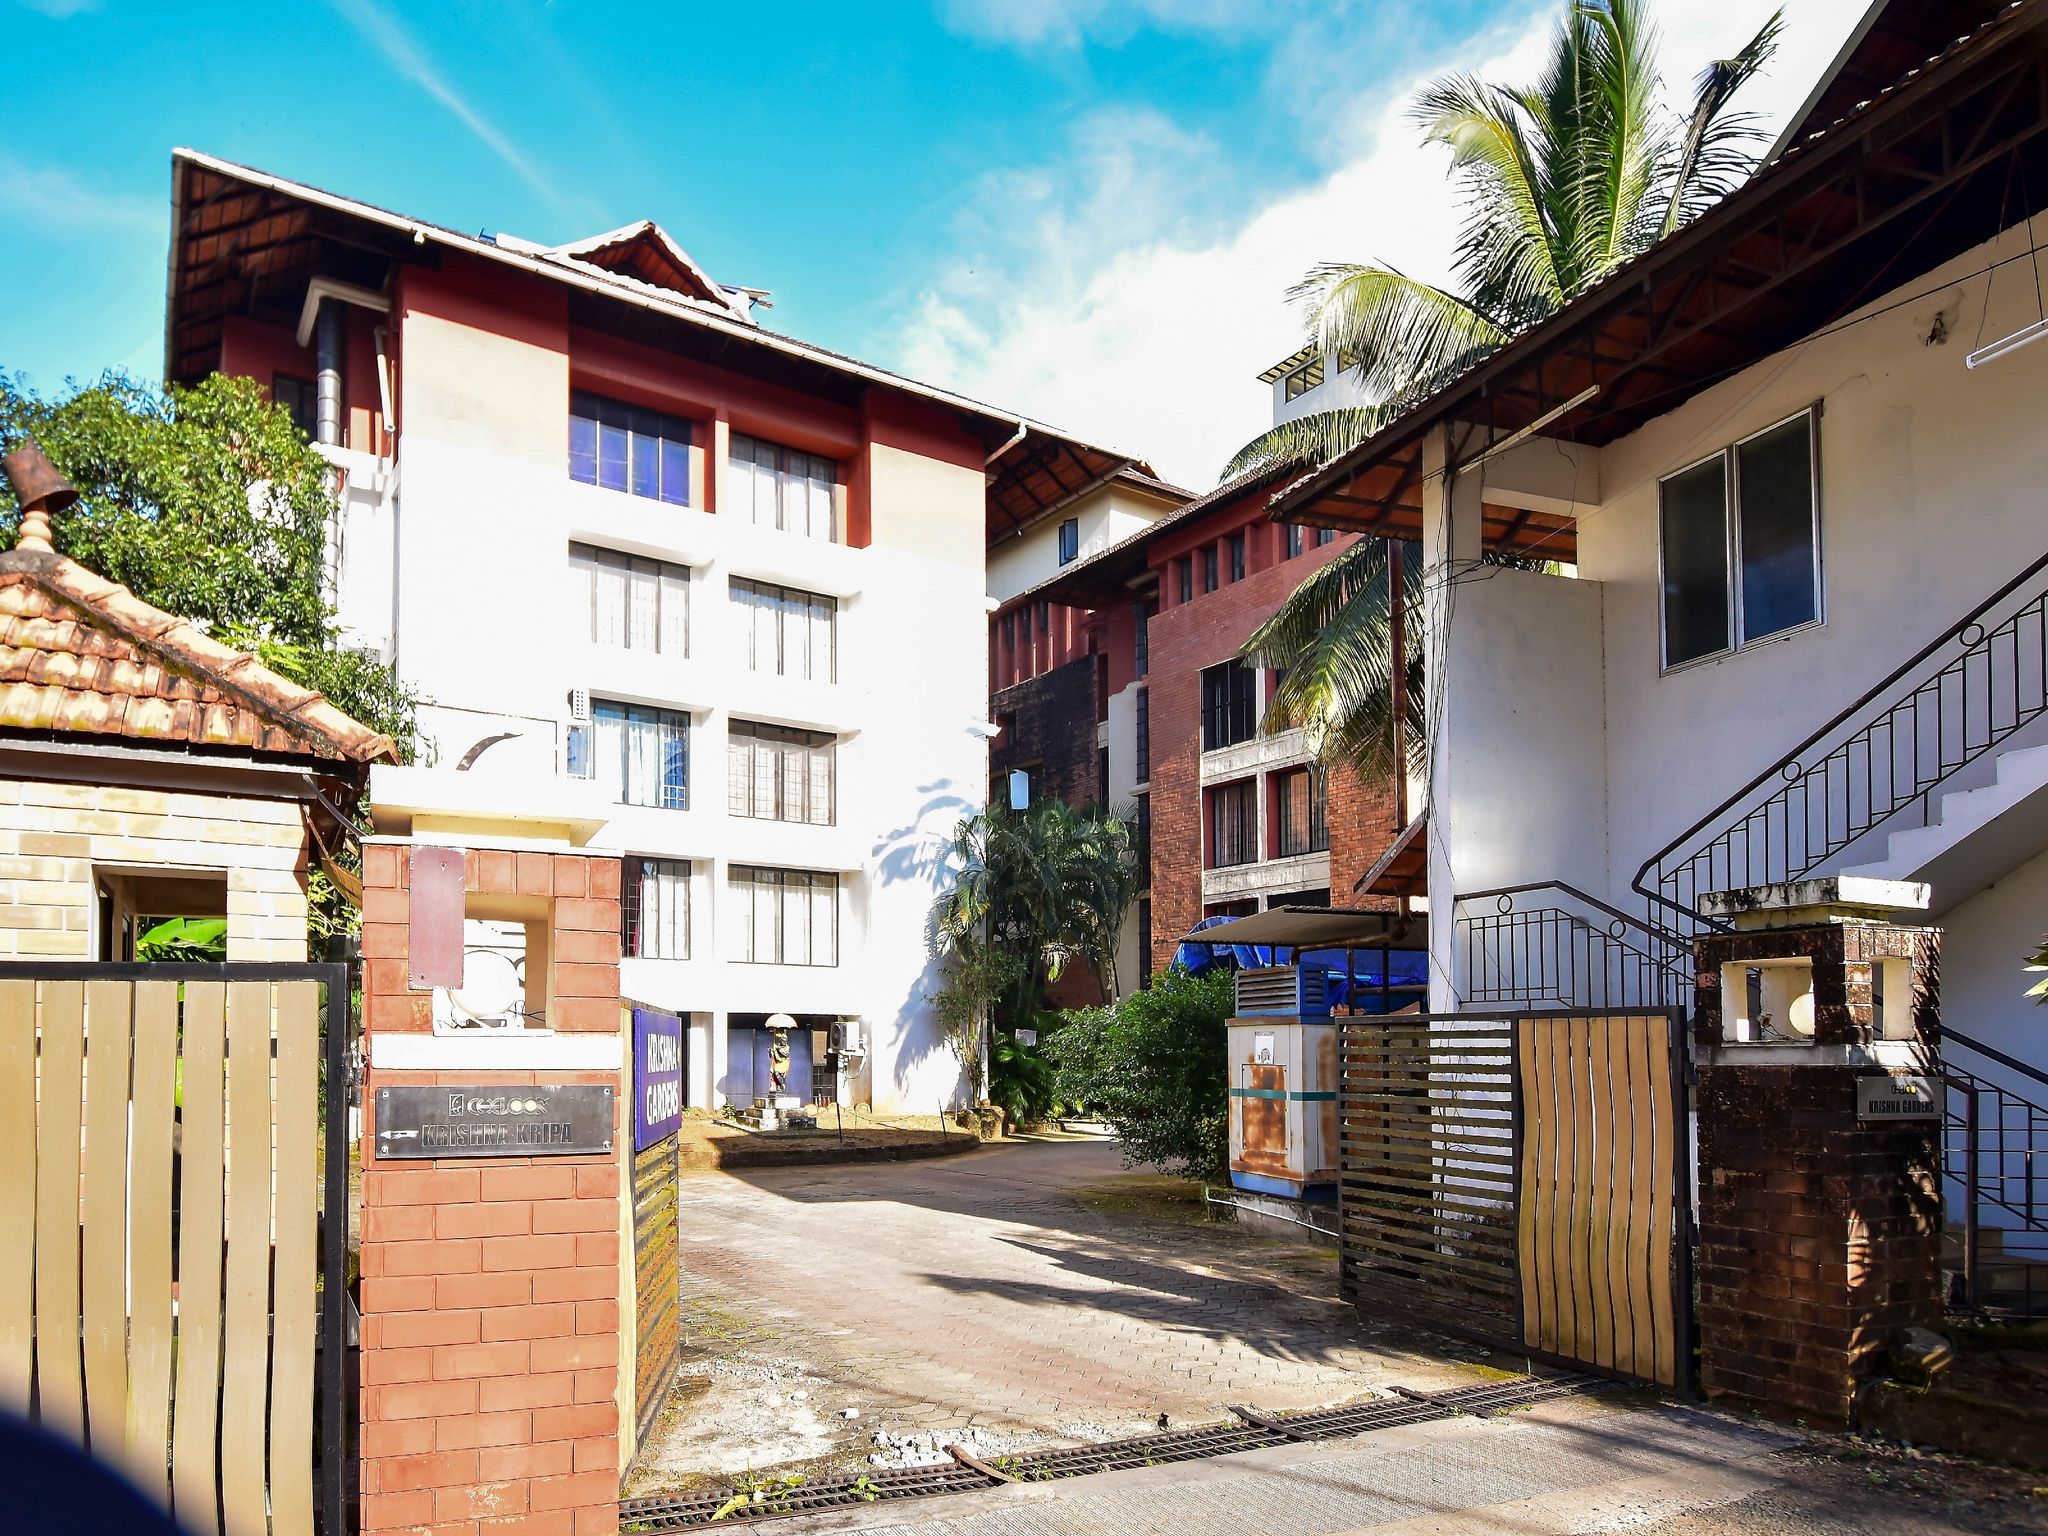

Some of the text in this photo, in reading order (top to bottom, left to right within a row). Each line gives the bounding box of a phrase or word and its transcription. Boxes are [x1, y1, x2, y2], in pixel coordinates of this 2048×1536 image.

[647, 1033, 678, 1073] KRISHNA
[646, 1080, 678, 1126] GARDENS
[1869, 1101, 1934, 1113] KRISHNA GARDENS
[422, 1122, 573, 1147] KRISHNA KRIPA
